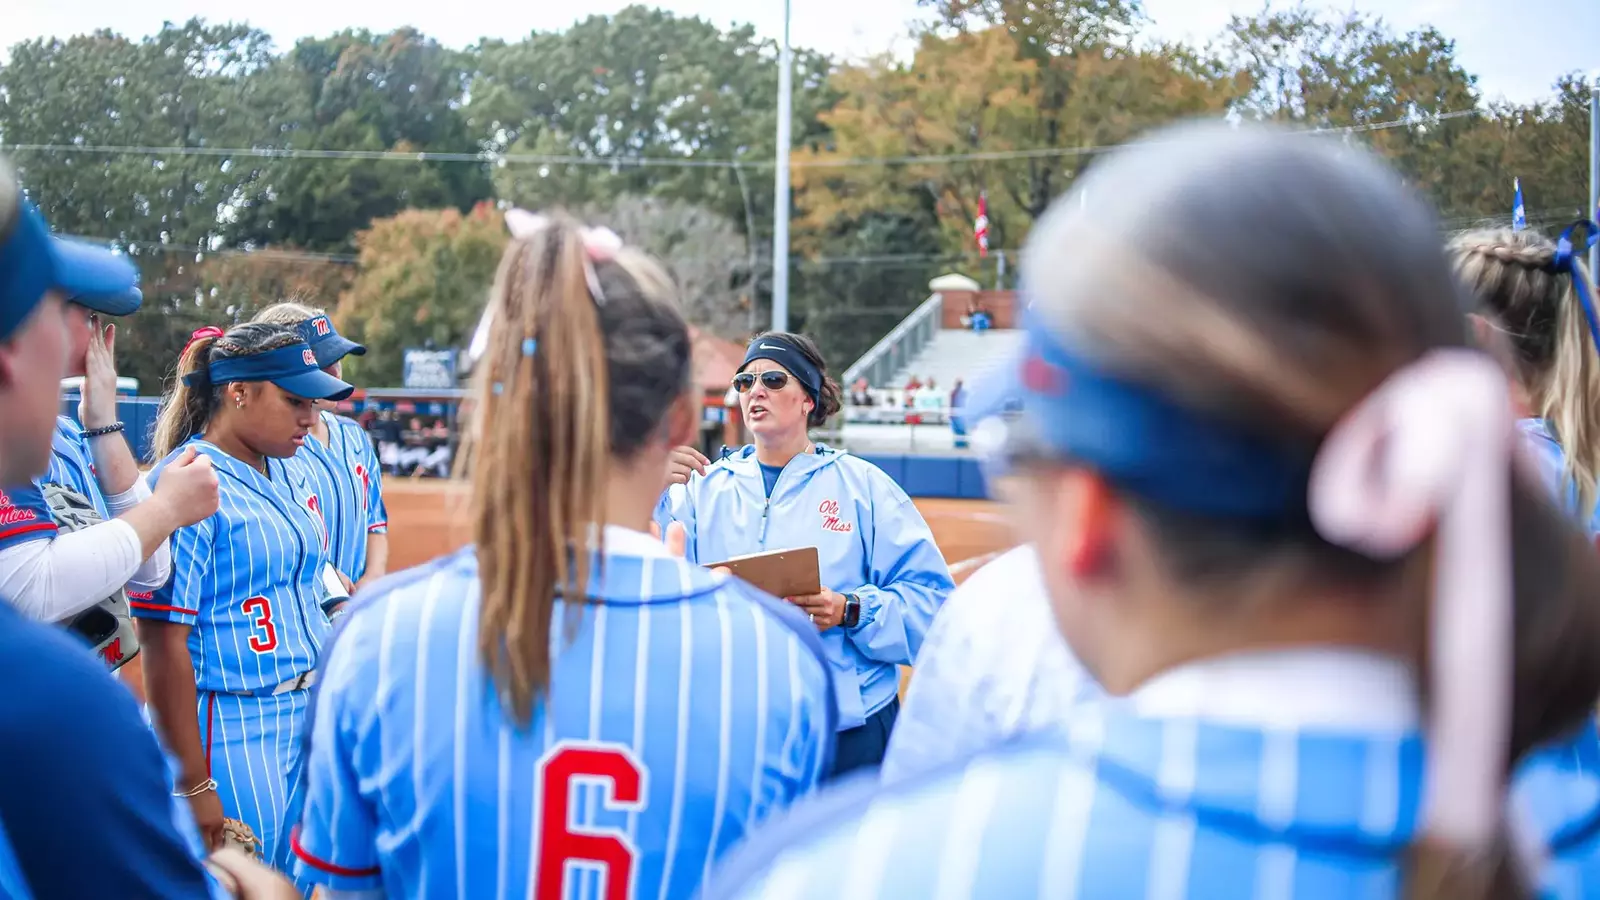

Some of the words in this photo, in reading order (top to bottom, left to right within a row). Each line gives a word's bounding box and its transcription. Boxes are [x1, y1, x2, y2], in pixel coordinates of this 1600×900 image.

[819, 499, 839, 515] Ole
[822, 515, 852, 532] Miss
[241, 594, 279, 655] 3
[527, 739, 649, 900] 6
